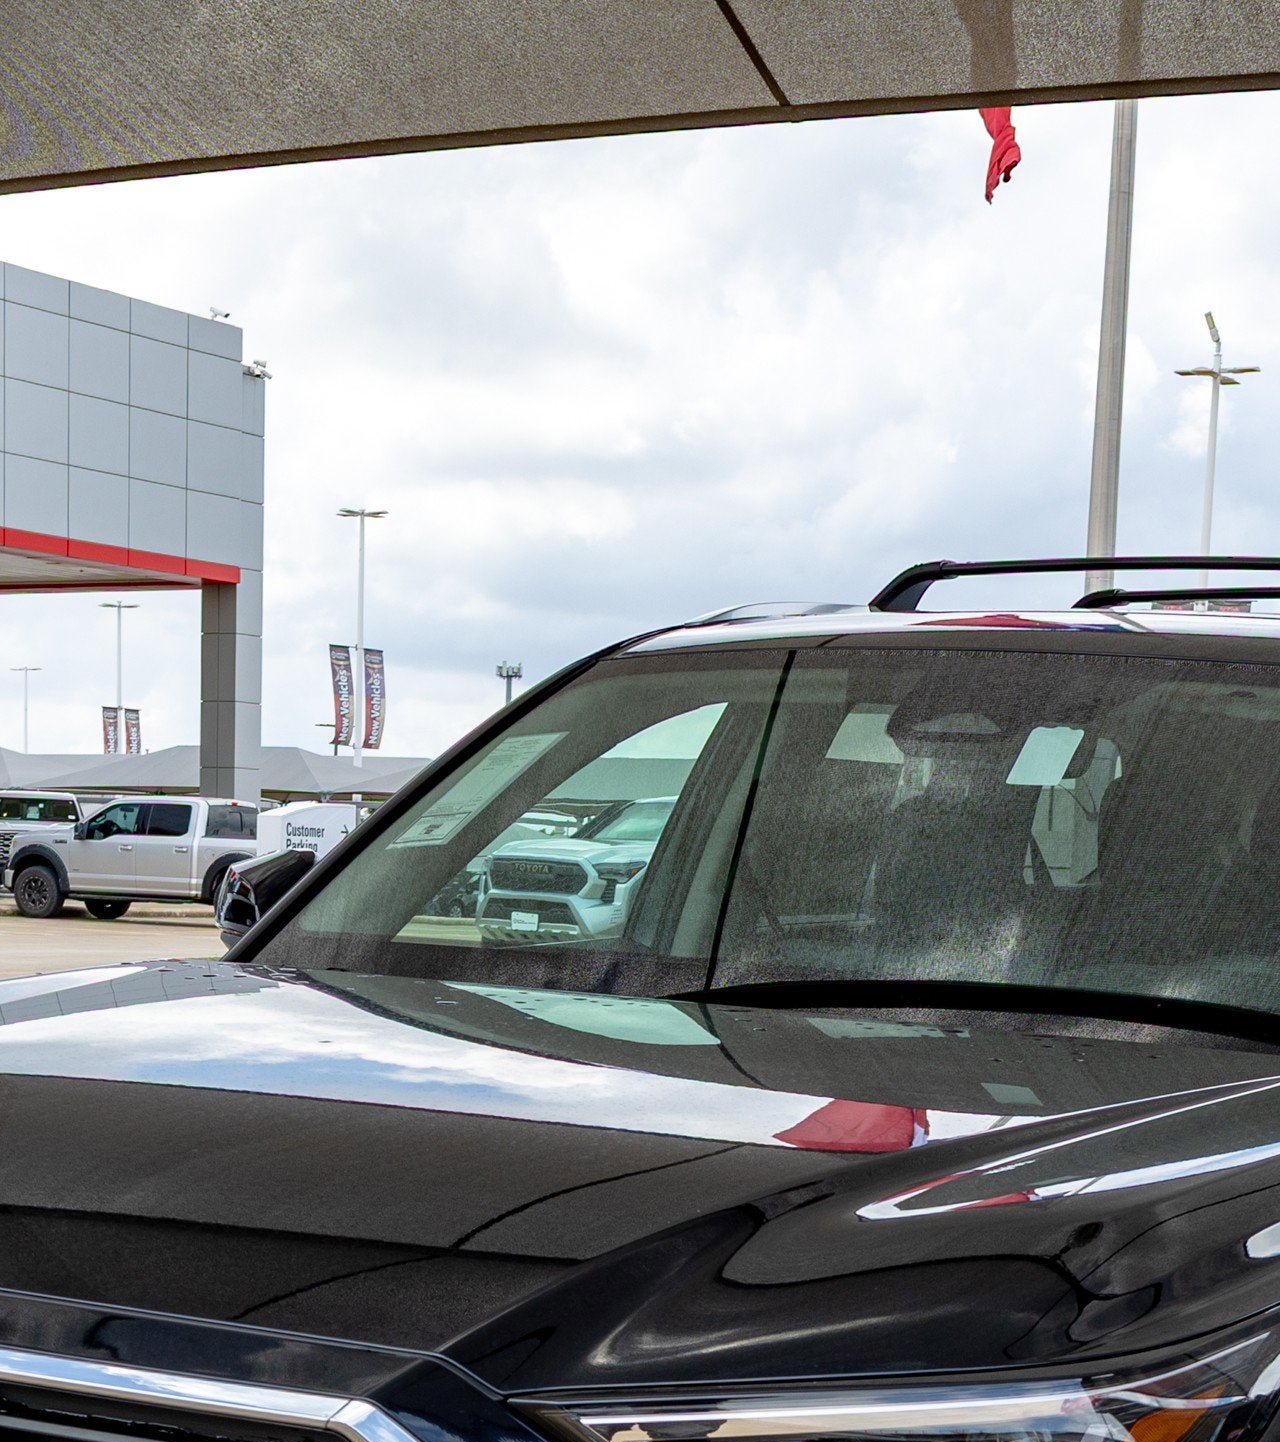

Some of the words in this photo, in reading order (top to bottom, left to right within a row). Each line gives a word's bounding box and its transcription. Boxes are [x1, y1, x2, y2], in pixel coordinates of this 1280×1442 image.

[338, 669, 350, 715] Vehicles
[370, 672, 381, 718] Vehicles
[338, 717, 350, 741] New
[368, 719, 380, 745] New
[286, 822, 325, 838] Customer
[286, 838, 318, 853] Parking
[515, 863, 550, 873] TOYOTA
